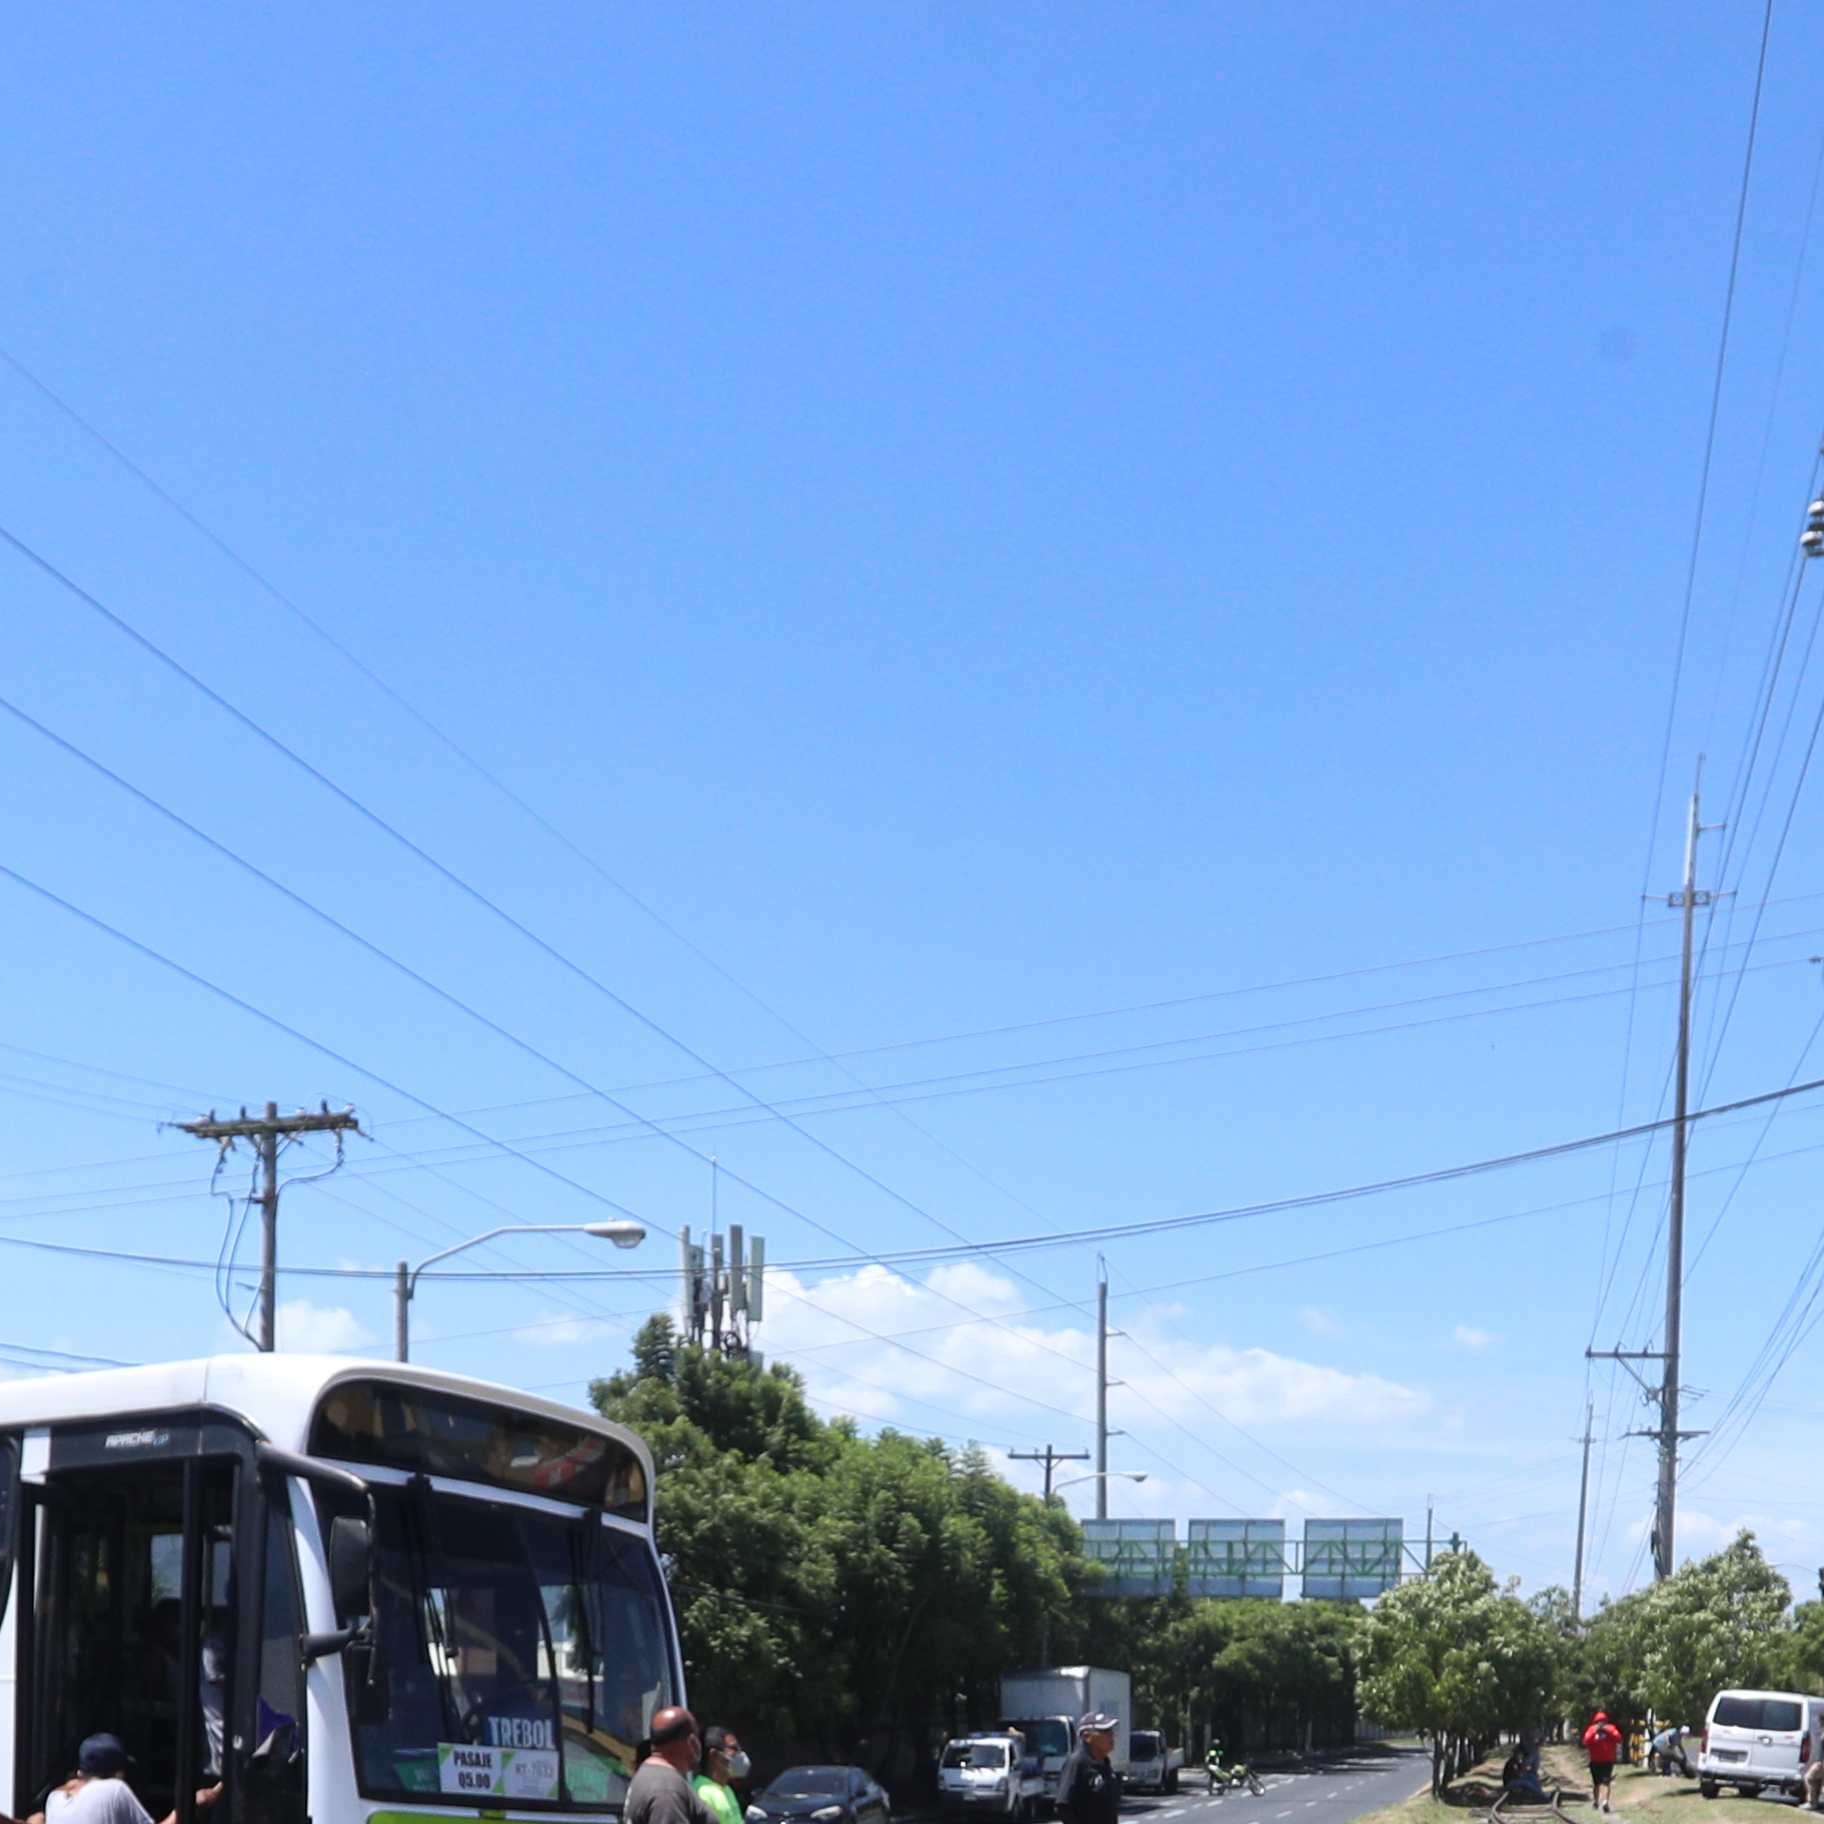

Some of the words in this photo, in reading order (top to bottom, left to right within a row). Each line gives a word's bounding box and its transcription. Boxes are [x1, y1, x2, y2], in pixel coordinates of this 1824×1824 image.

[487, 1716, 556, 1749] TREBOL
[453, 1750, 492, 1768] PASAJE
[457, 1772, 491, 1790] Q5.00
